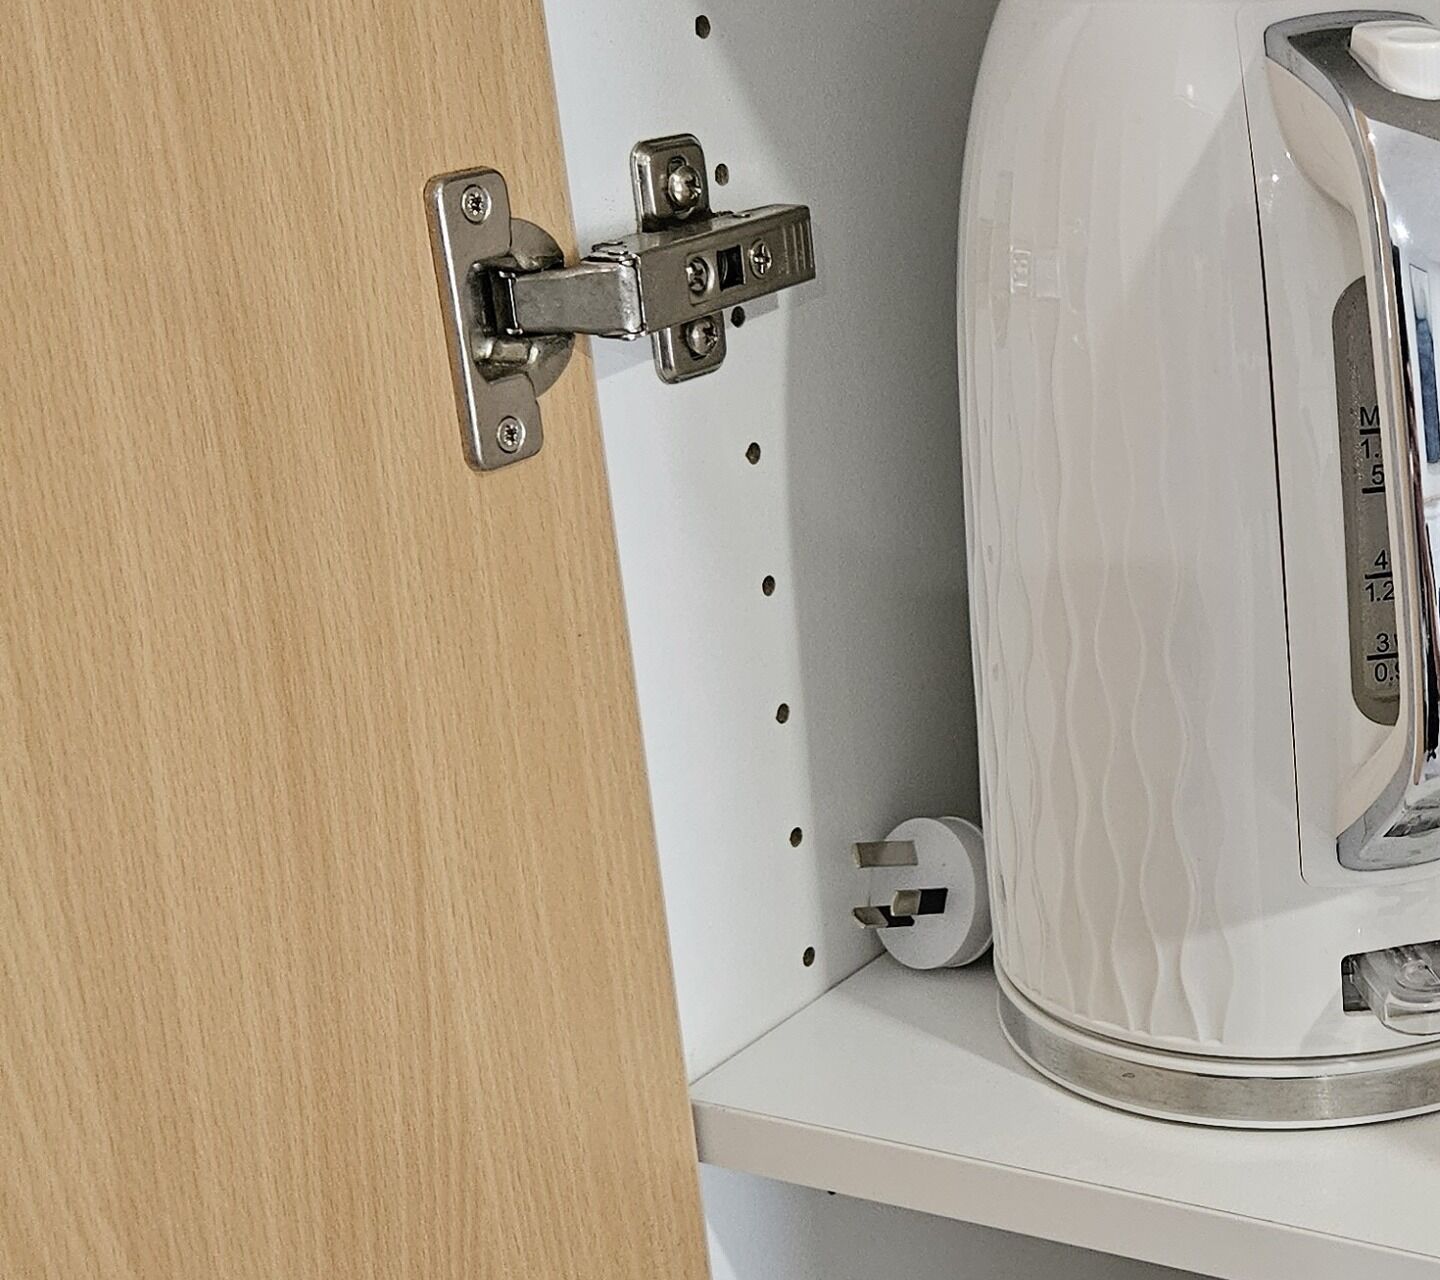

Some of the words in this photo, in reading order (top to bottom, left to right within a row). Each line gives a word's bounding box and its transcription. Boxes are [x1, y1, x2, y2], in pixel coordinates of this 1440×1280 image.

[1360, 440, 1382, 458] 1.
[1371, 465, 1385, 485] 5
[1374, 549, 1388, 570] 4
[1364, 582, 1395, 602] 1.2
[1376, 633, 1390, 653] 3
